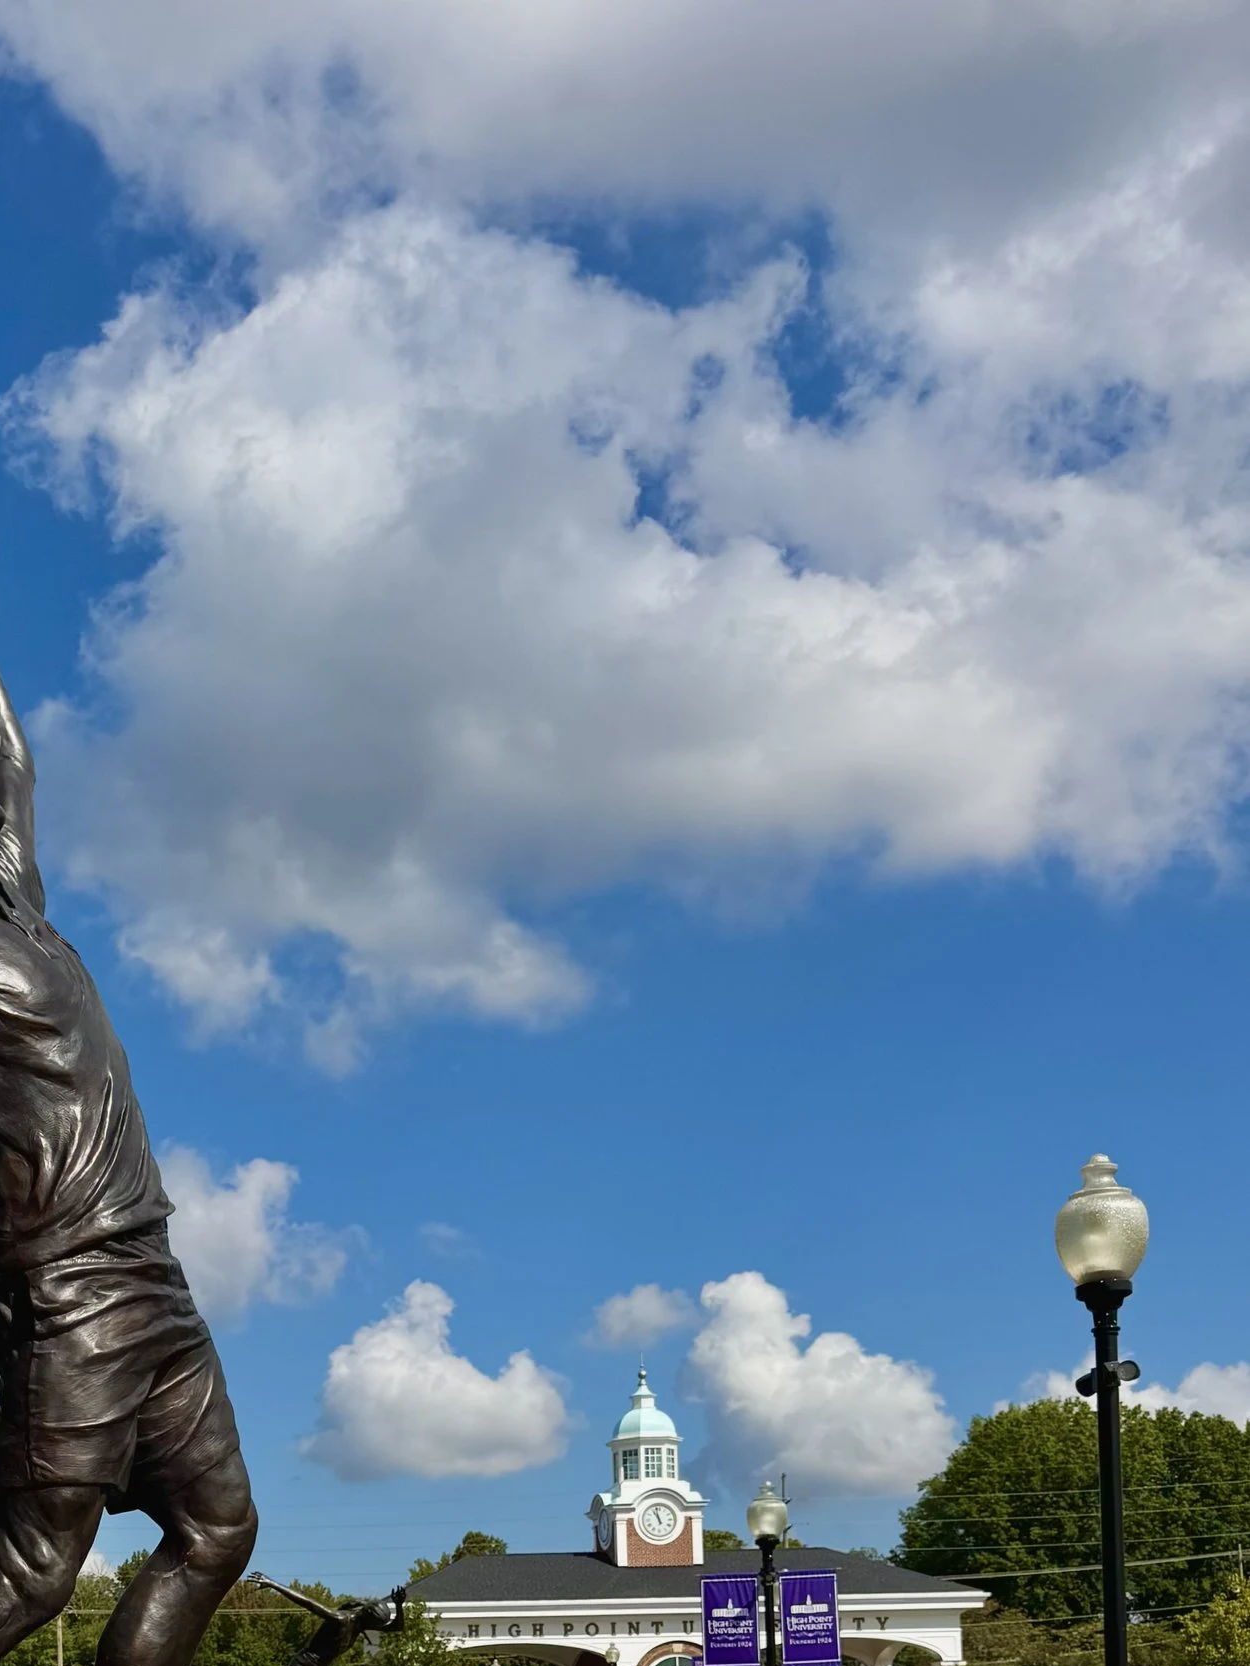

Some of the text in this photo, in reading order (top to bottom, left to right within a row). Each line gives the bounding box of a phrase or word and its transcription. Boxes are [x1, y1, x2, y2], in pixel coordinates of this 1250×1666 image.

[707, 1619, 729, 1628] HIGH
[786, 1616, 808, 1625] HIGH
[808, 1615, 834, 1623] POINT
[467, 1622, 545, 1639] HIGH
[562, 1620, 664, 1638] POINT
[708, 1626, 754, 1635] UNIVERSITY
[787, 1622, 834, 1632] UNIVERSITY
